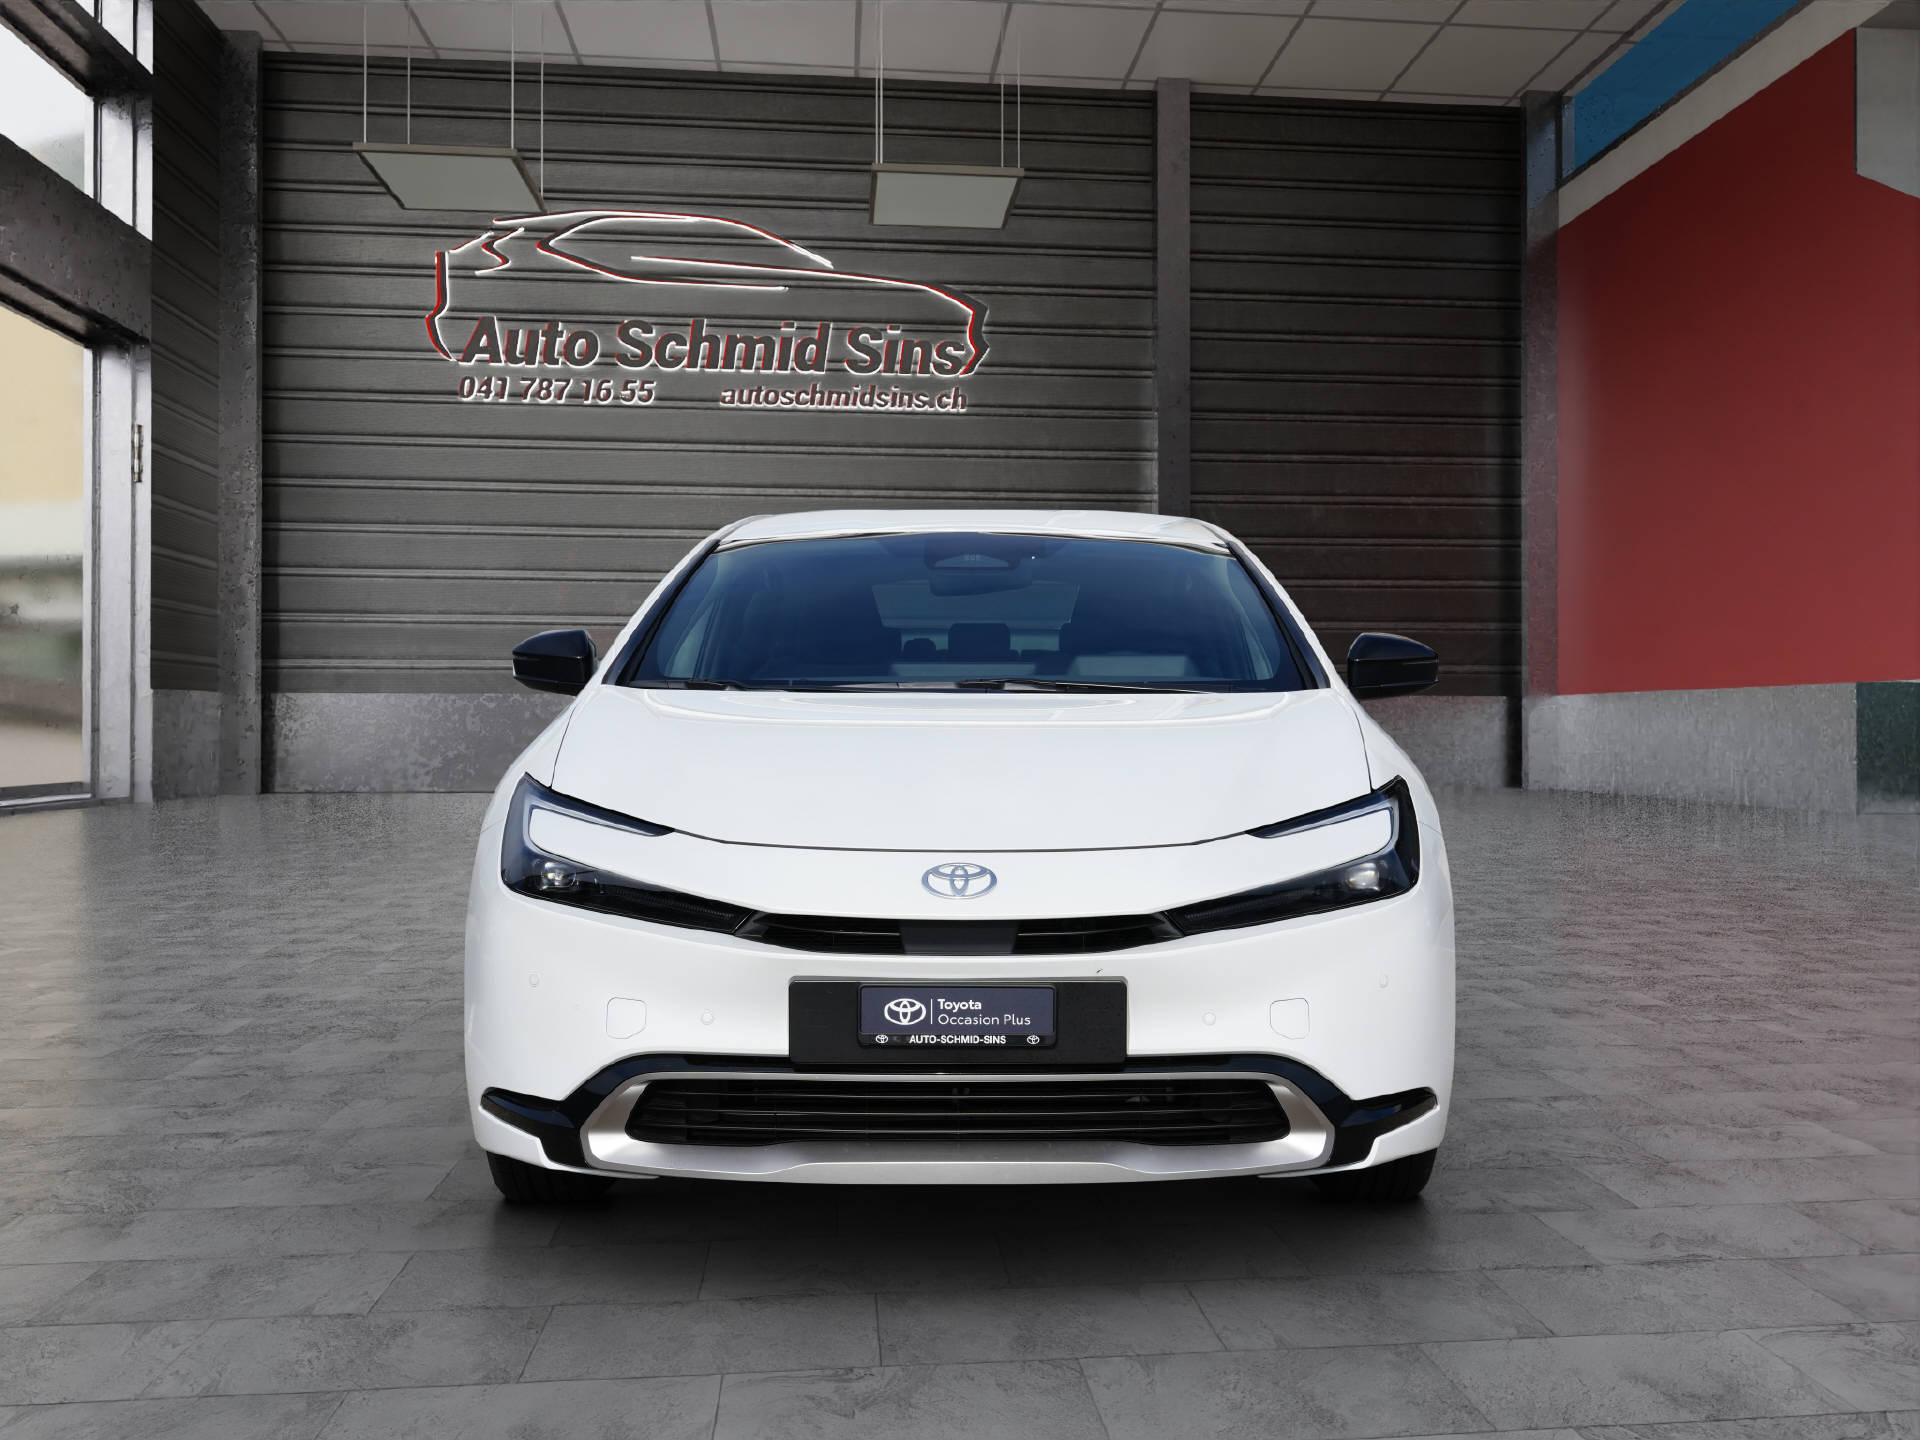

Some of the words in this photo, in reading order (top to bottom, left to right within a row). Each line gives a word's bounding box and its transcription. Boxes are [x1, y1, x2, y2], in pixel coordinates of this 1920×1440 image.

[459, 315, 600, 368] Auto
[615, 317, 833, 374] Schmid
[844, 324, 966, 377] Sins
[459, 375, 510, 402] 041
[519, 376, 572, 403] 787
[582, 378, 614, 404] 16
[620, 379, 656, 405] 55
[719, 382, 968, 411] autoschmidsins.ch
[937, 998, 982, 1012] Toyota
[937, 1013, 1000, 1026] Occasion
[1003, 1013, 1031, 1026] Plus
[909, 1034, 1007, 1045] AUTO-SCHMID-SINS
